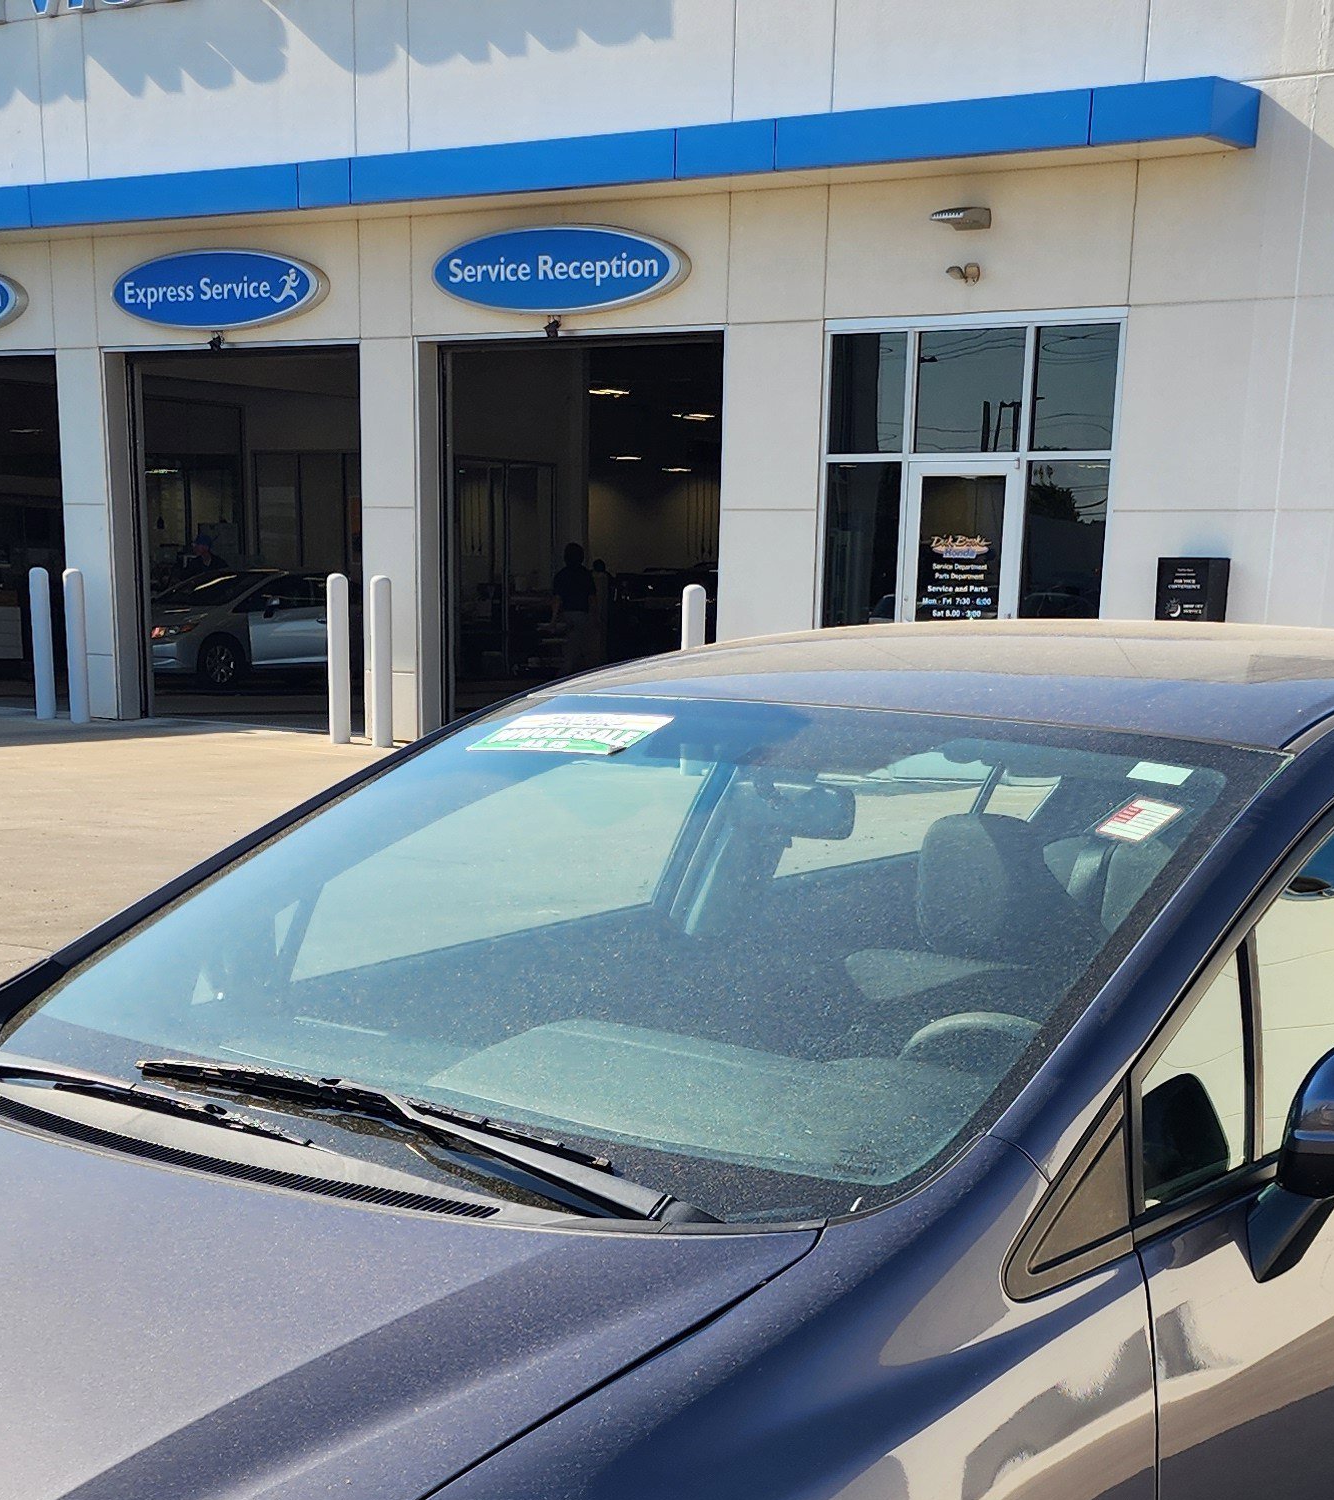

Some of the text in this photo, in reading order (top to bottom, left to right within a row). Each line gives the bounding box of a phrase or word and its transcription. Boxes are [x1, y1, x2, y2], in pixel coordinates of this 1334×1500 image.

[447, 252, 659, 286] Service Reception
[123, 275, 271, 310] Express Service
[930, 534, 954, 548] Dick
[954, 563, 988, 571] Department
[934, 572, 949, 580] Parts
[927, 585, 988, 593] Service and Parts
[922, 597, 937, 606] Mon
[932, 609, 944, 617] Sat
[486, 728, 646, 747] WHOLESALE
